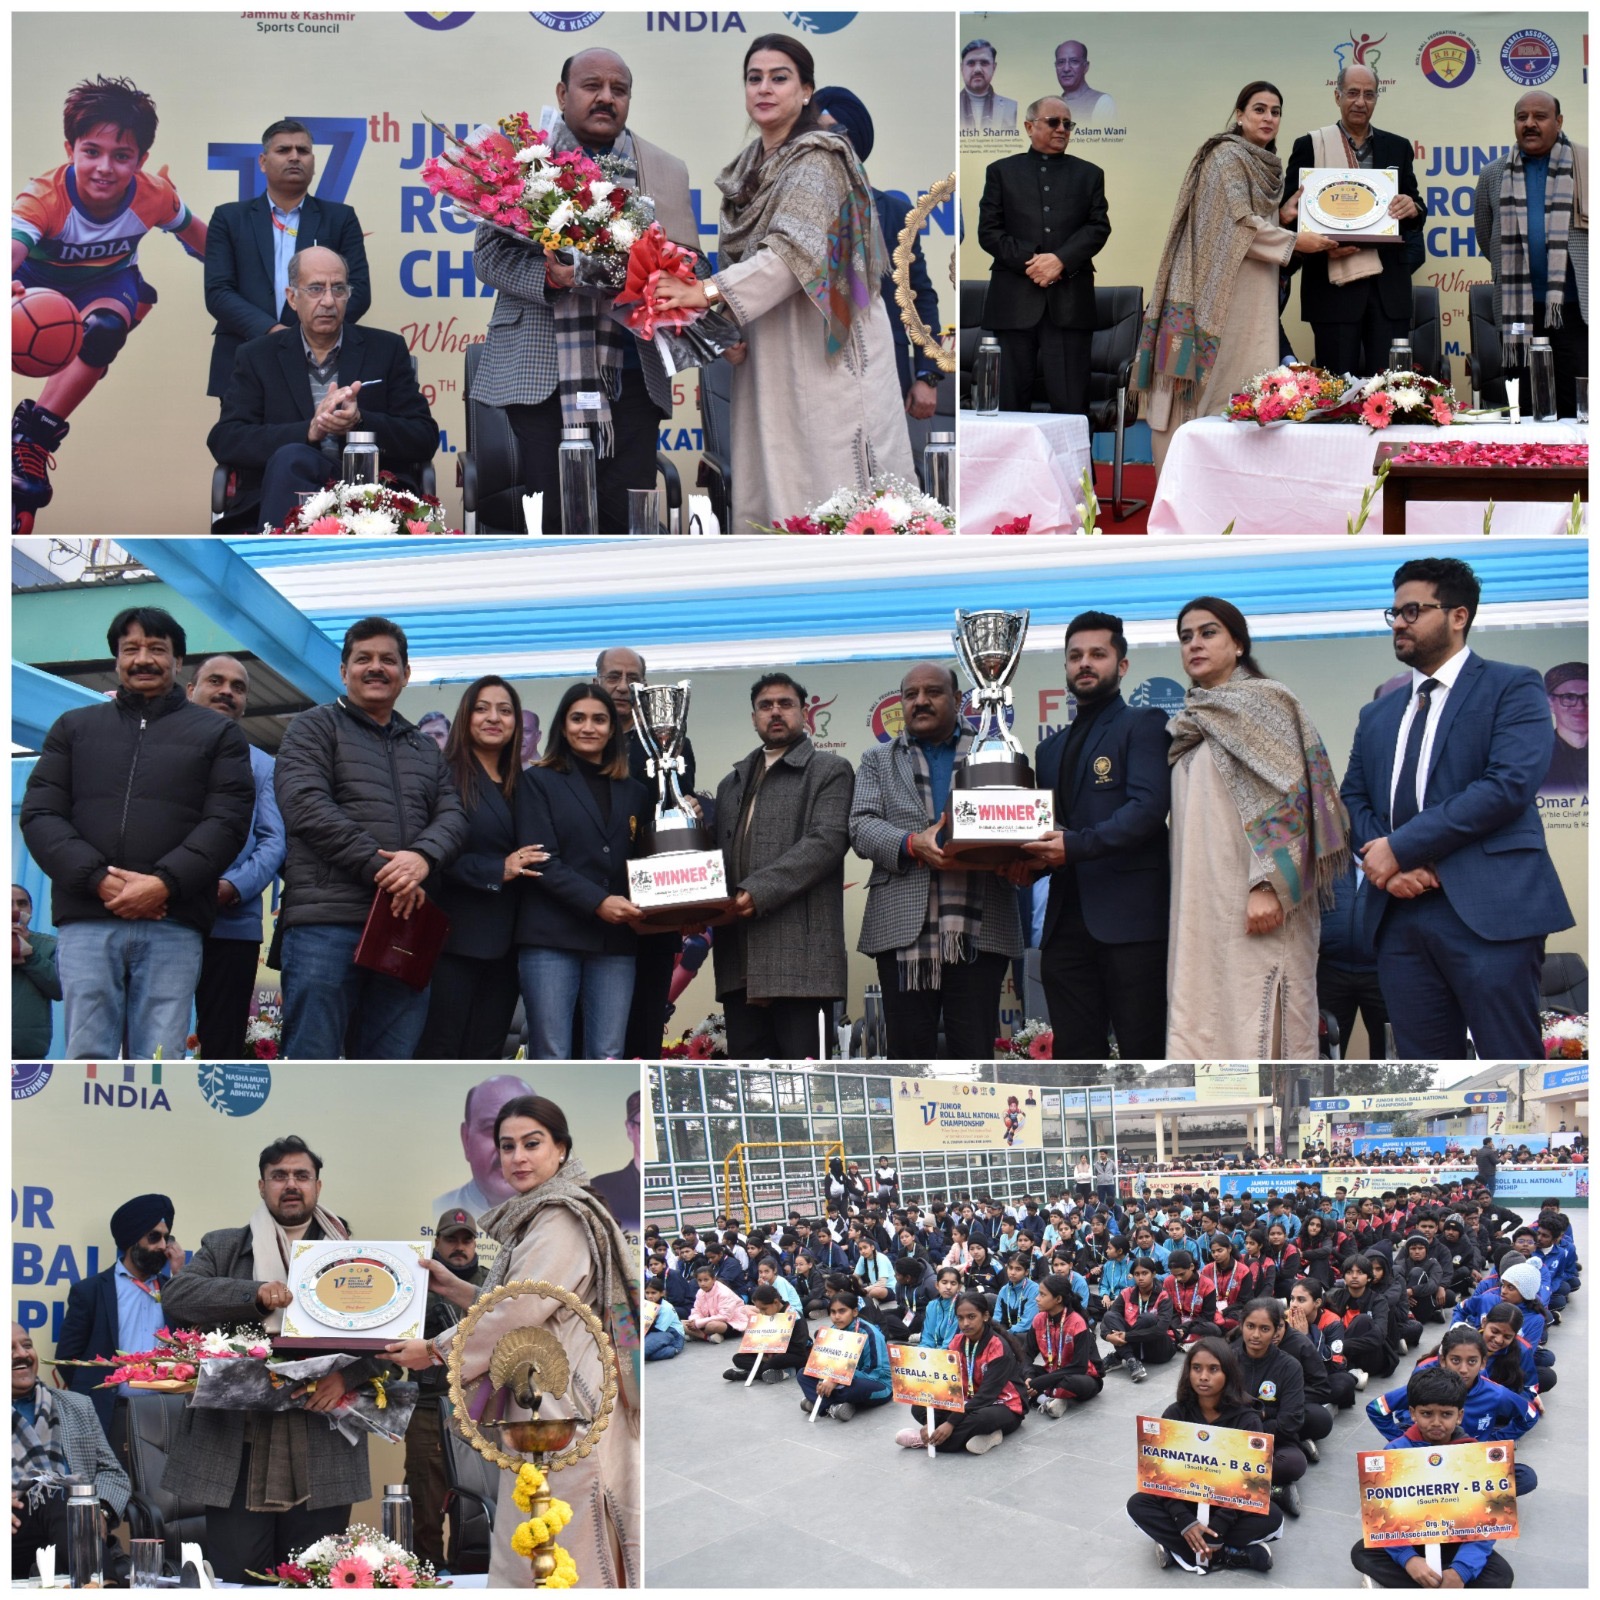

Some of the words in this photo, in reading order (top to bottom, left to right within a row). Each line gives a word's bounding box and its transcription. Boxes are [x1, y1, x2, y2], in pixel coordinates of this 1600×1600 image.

[241, 11, 287, 20] Jammu
[290, 11, 300, 20] &
[303, 11, 355, 21] Kashmir
[647, 12, 747, 32] INDIA
[257, 22, 294, 33] Sports
[297, 23, 339, 33] Council
[559, 21, 566, 30] &
[1427, 30, 1457, 41] FEDERATION
[1502, 31, 1524, 59] ROLLBALL
[1525, 30, 1558, 57] ASSOCIATION
[1503, 64, 1523, 85] JAMMU
[1532, 64, 1557, 85] KASHMIR
[960, 128, 979, 137] tish
[983, 128, 1020, 137] Sharma
[1074, 127, 1101, 136] Aslam
[1104, 127, 1127, 135] Wani
[1427, 186, 1476, 216] RO
[60, 240, 131, 260] INDIA
[400, 316, 486, 353] Wher
[814, 741, 847, 749] Kashmir
[1535, 796, 1576, 809] Omar
[978, 804, 1036, 820] WINNER
[653, 866, 708, 887] WINNER
[258, 991, 276, 1004] SAY
[225, 1073, 249, 1082] NASHA
[249, 1076, 269, 1084] MUKT
[14, 1071, 50, 1099] KASHMIR
[233, 1082, 261, 1090] BHARAT
[84, 1081, 172, 1112] INDIA
[230, 1089, 265, 1099] ABHIYAAN
[939, 1102, 961, 1110] JUNIOR
[1361, 1098, 1373, 1110] 17
[920, 1101, 937, 1126] 17
[939, 1111, 956, 1119] ROLL
[957, 1111, 972, 1119] BALL
[972, 1112, 1000, 1120] NATIONAL
[940, 1119, 985, 1127] CHAMPIONSHIP
[477, 1243, 499, 1252] eputy
[334, 1276, 346, 1288] 17
[894, 1367, 927, 1378] KERALA
[951, 1374, 957, 1382] G
[1143, 1445, 1219, 1467] KARNATAKA
[1230, 1460, 1238, 1470] B
[1242, 1462, 1252, 1472] &
[1256, 1464, 1266, 1474] G
[1184, 1463, 1203, 1471] (South
[1204, 1467, 1222, 1475] Zone)
[1143, 1481, 1154, 1489] Roll
[1155, 1483, 1167, 1491] Ball
[1167, 1485, 1202, 1497] Association
[1210, 1492, 1232, 1503] Jammu
[1237, 1496, 1264, 1508] Kashmir
[1367, 1482, 1460, 1500] PONDICHERRY
[1471, 1481, 1481, 1492] B
[1485, 1480, 1495, 1491] &
[1499, 1478, 1508, 1490] G
[1417, 1497, 1439, 1506] (South
[1440, 1496, 1460, 1504] Zone)
[1425, 1520, 1440, 1528] Org.
[1370, 1532, 1384, 1541] Roll
[1385, 1531, 1399, 1540] Ball
[1400, 1529, 1440, 1539] Association
[1441, 1528, 1449, 1536] of
[1450, 1527, 1474, 1536] Jammu
[1476, 1526, 1482, 1534] &
[1483, 1524, 1512, 1533] Kashmir
